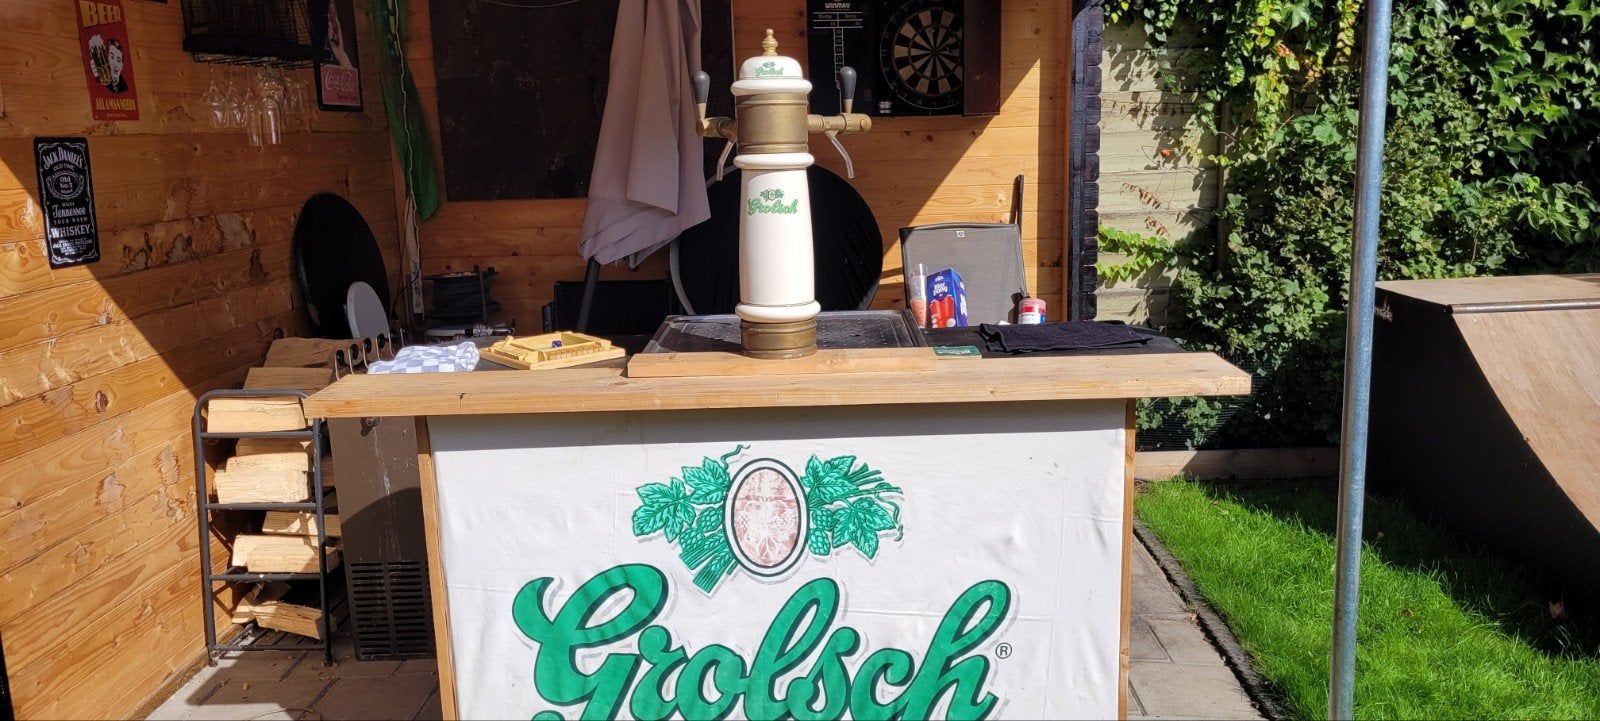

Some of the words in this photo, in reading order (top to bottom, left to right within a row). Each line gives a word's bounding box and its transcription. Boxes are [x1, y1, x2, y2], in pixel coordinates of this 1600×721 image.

[79, 0, 122, 27] BEER
[42, 150, 59, 170] JACK
[52, 204, 86, 218] Tennessee
[747, 198, 799, 217] Grolsch
[51, 224, 91, 239] WHISKEY
[512, 563, 1011, 721] Grolsch
